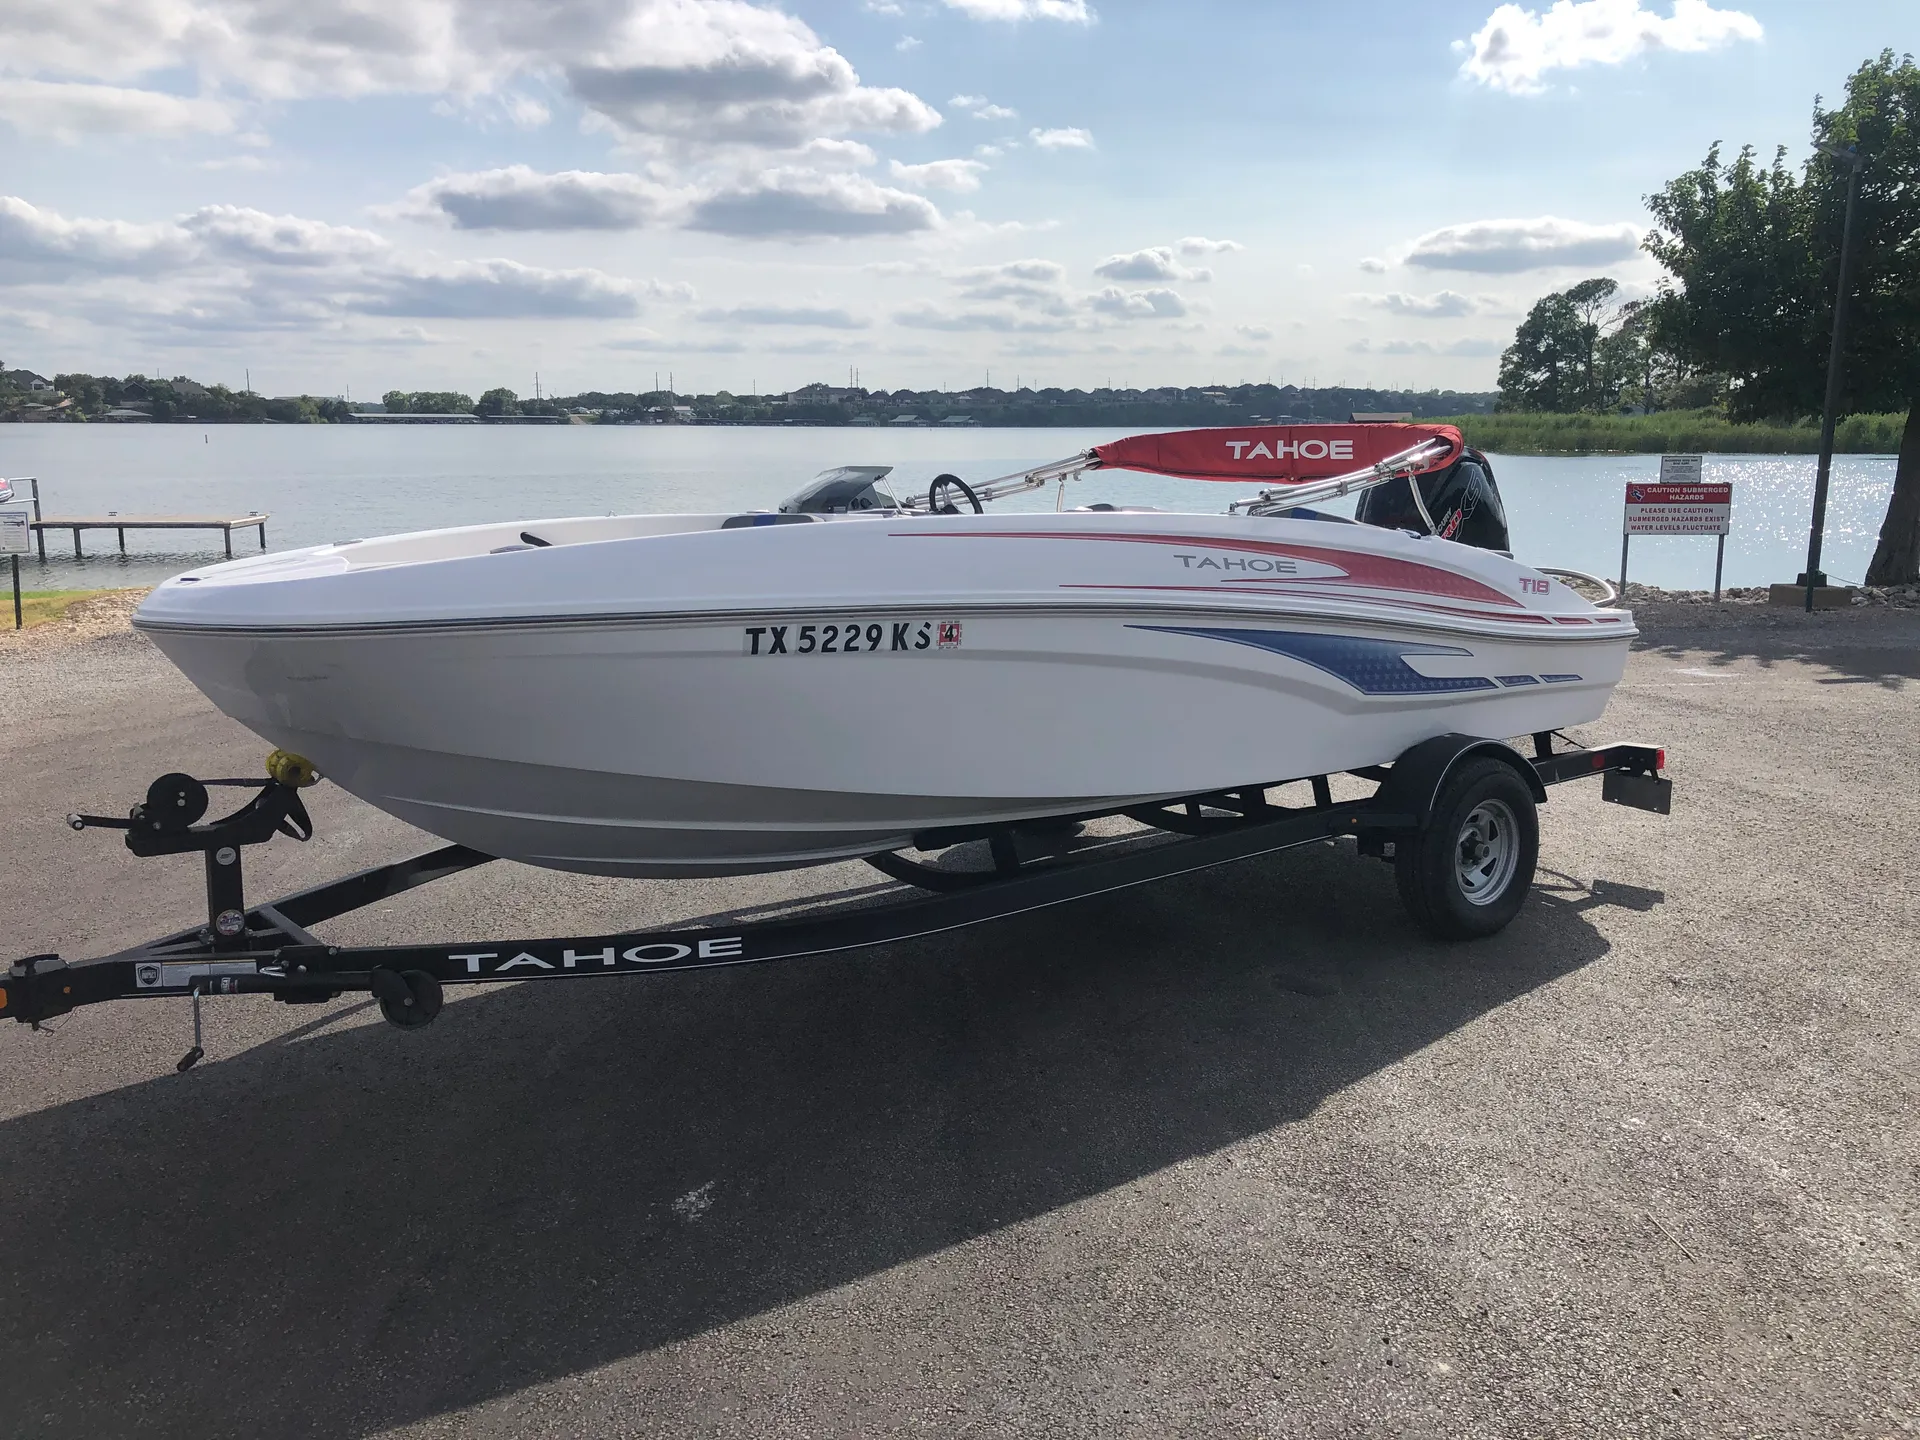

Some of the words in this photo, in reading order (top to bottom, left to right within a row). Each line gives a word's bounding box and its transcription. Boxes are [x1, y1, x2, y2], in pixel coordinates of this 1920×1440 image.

[1225, 439, 1354, 460] TAHOE
[1173, 554, 1297, 574] TAHOE
[1519, 577, 1550, 595] T18
[745, 625, 788, 655] TX
[797, 623, 884, 654] 5229
[891, 621, 932, 651] KS
[944, 624, 954, 642] 4
[448, 936, 743, 973] TAHOE
